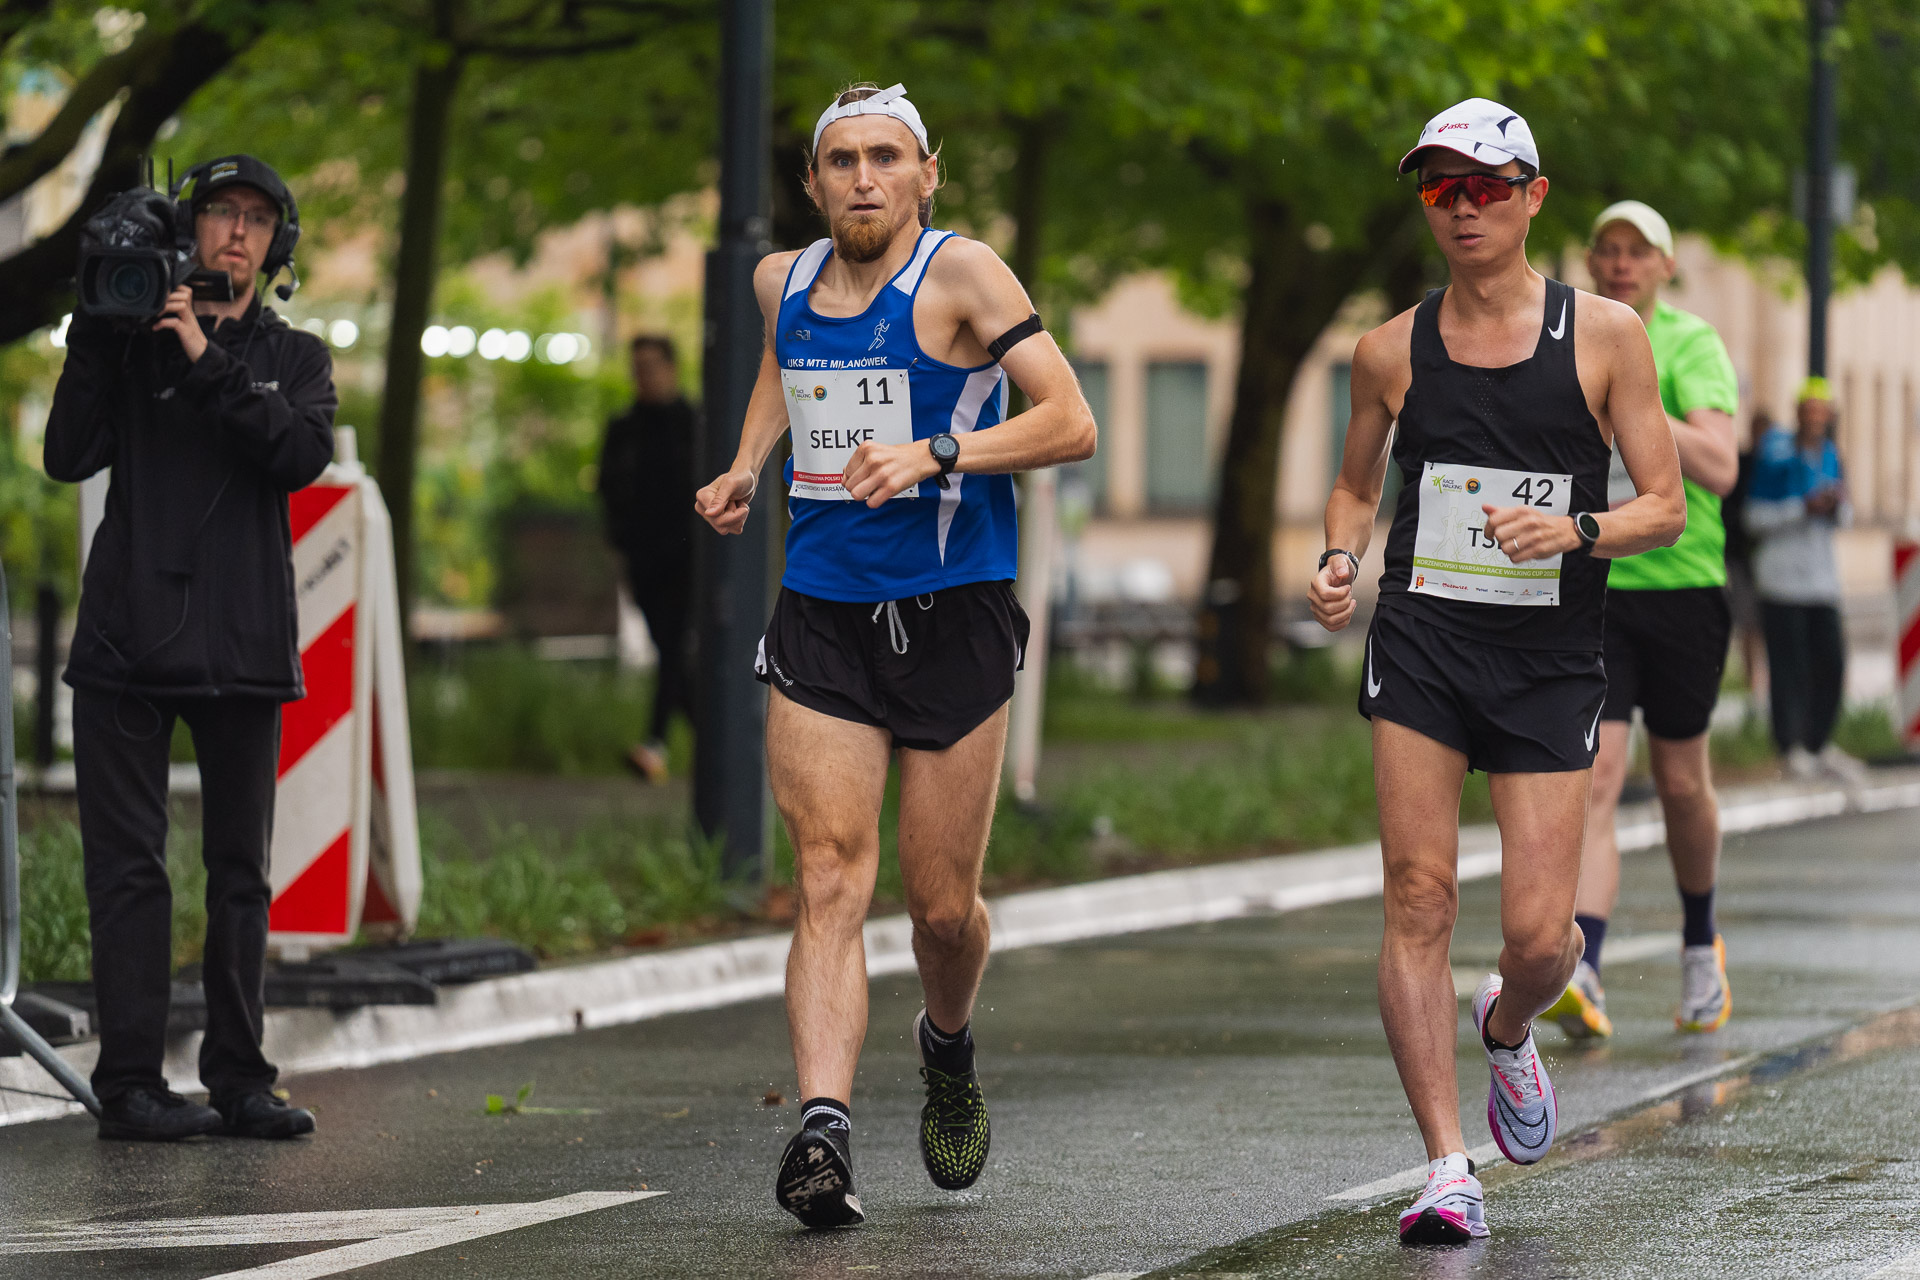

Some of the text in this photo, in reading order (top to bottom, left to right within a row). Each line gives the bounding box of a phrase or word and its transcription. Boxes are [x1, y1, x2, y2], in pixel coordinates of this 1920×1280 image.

[1447, 122, 1470, 130] asics
[787, 356, 888, 369] UKS MTE MILANÓWEK
[856, 376, 894, 406] 11
[1511, 476, 1554, 508] 42
[1467, 526, 1502, 550] TS
[1416, 559, 1458, 570] KORZENIOWSKI
[1458, 564, 1487, 573] WARSAW
[1487, 567, 1503, 575] RACE
[1503, 569, 1532, 577] WALKING
